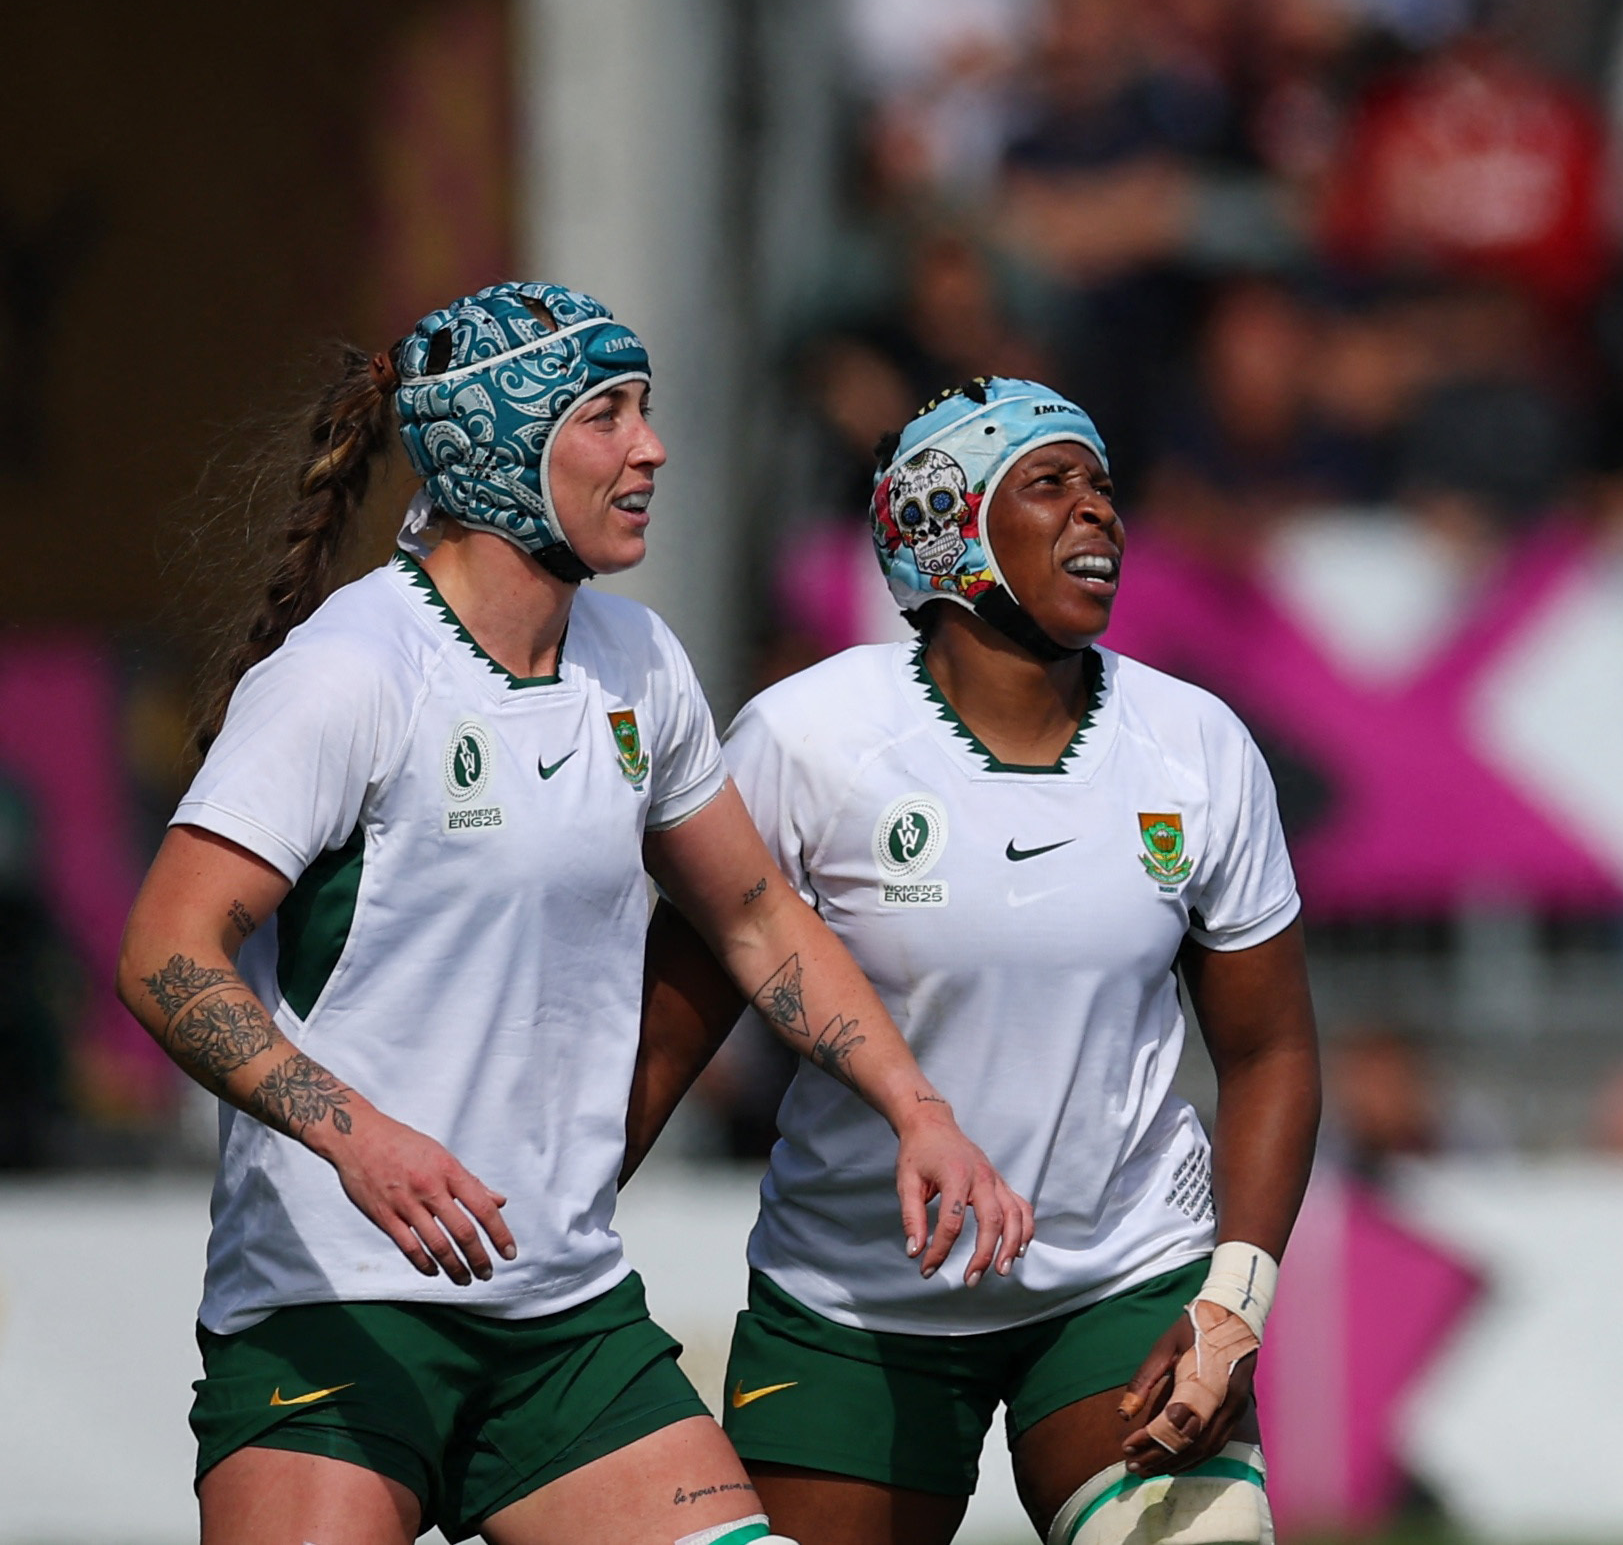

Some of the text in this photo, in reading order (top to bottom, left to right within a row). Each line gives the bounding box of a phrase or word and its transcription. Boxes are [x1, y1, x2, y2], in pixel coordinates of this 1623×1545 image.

[448, 807, 502, 819] WOMEN'S
[448, 815, 503, 830] ENG25
[883, 884, 943, 893] WOMEN'S
[884, 892, 943, 903] ENG25
